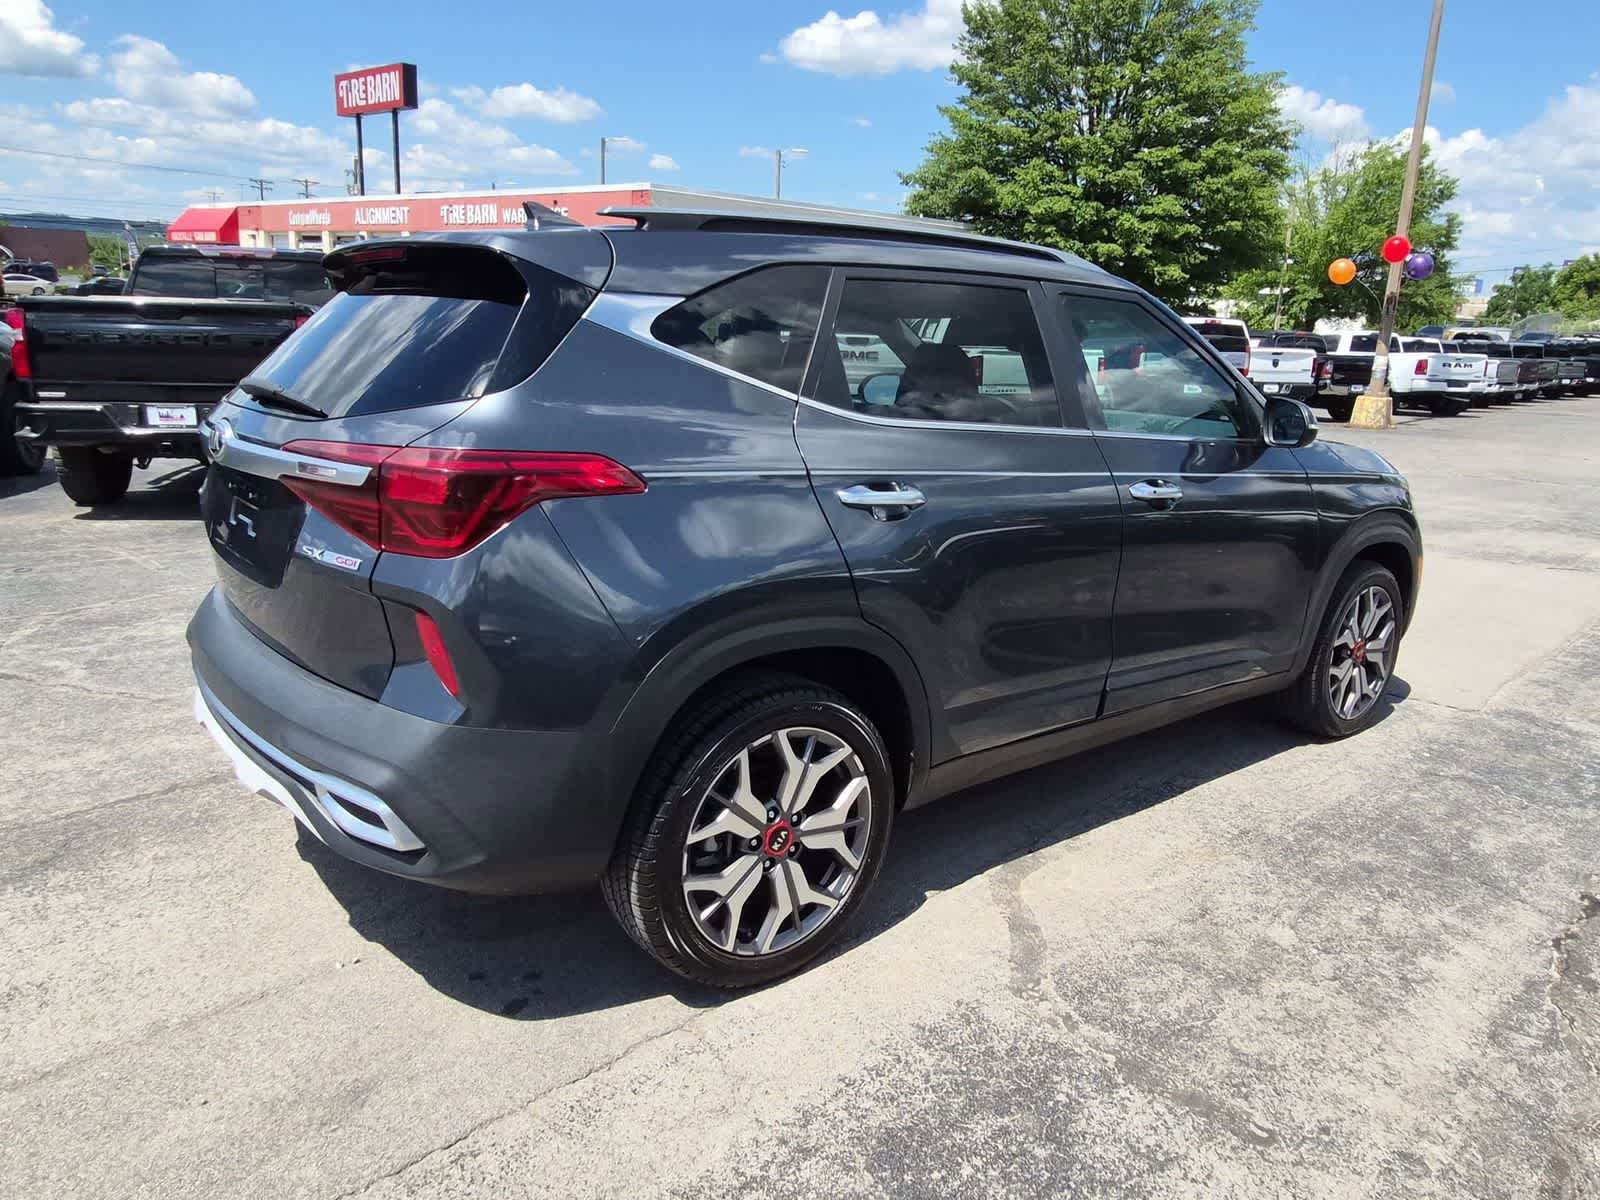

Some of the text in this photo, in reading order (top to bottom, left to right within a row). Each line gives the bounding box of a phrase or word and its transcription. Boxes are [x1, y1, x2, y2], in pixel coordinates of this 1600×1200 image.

[367, 70, 400, 105] BARN
[355, 206, 409, 225] ALIGNMENT
[467, 203, 498, 225] BARN
[302, 545, 326, 560] SX
